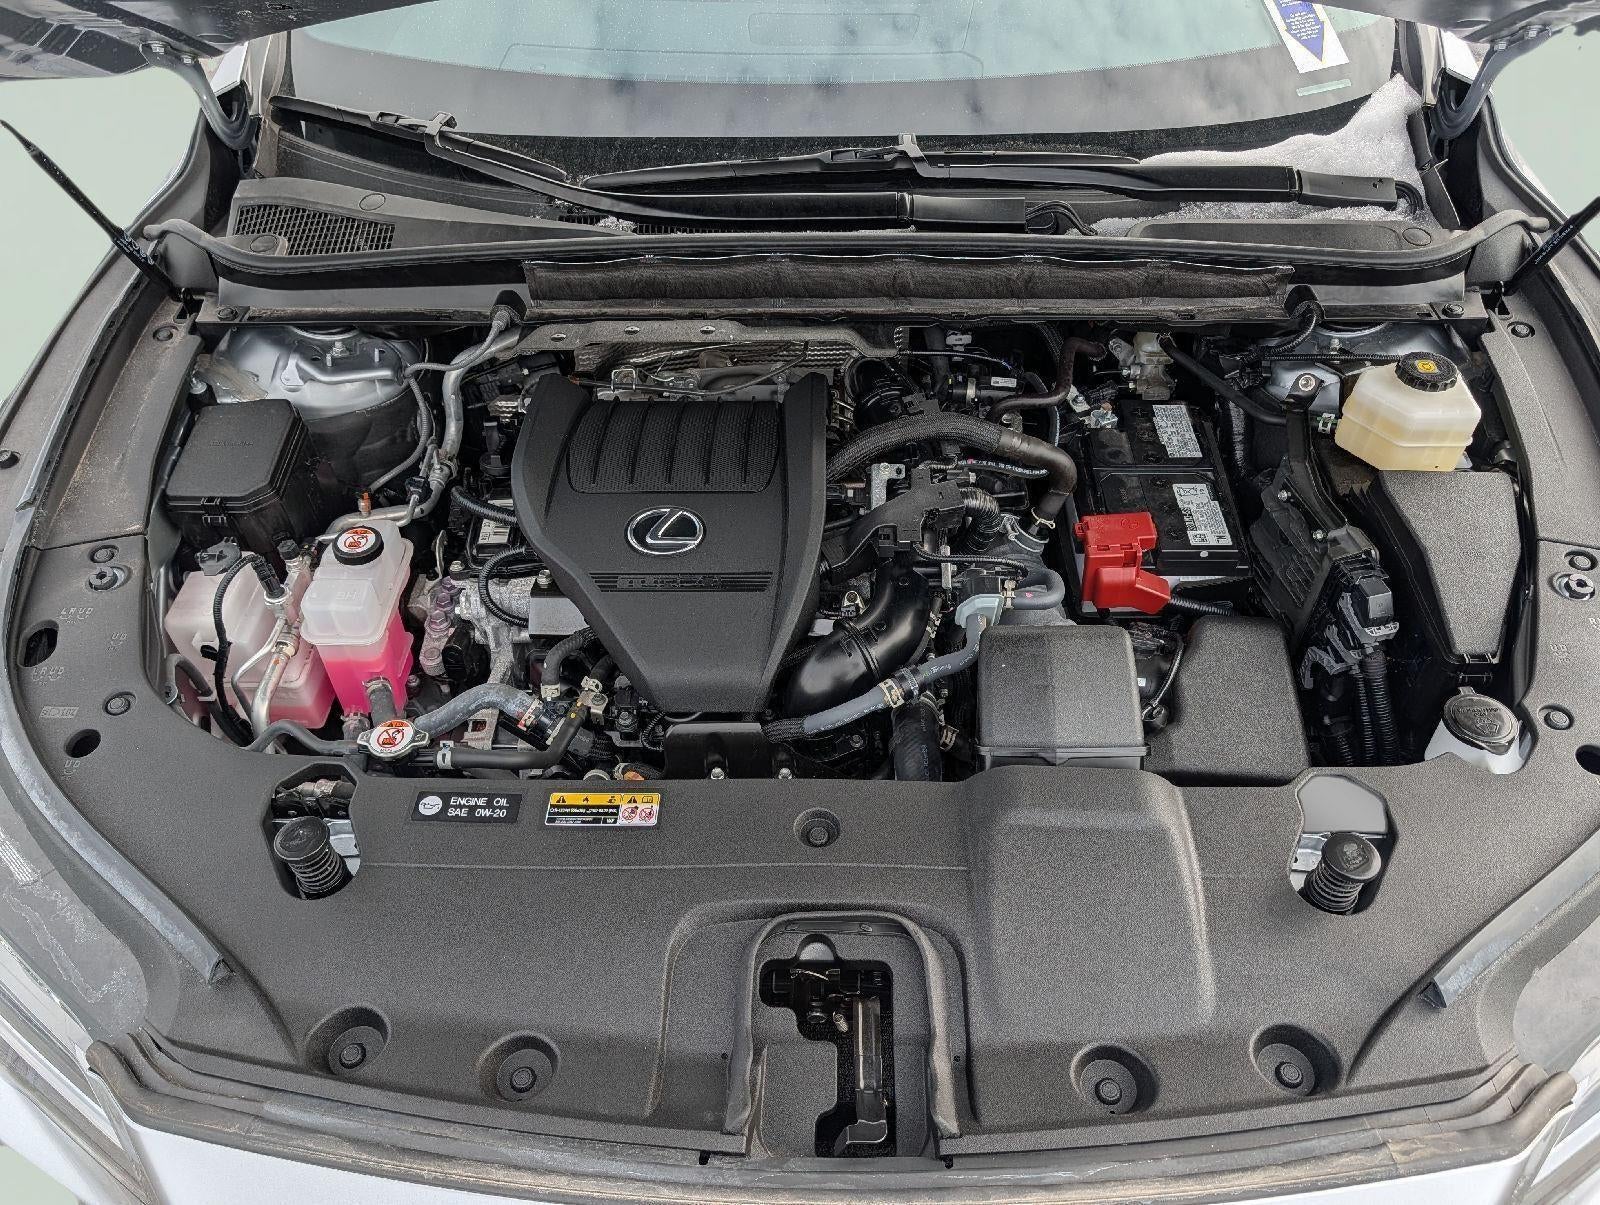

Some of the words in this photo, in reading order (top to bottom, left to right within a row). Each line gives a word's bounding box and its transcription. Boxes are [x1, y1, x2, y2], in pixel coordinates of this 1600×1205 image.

[450, 796, 488, 806] ENGINE
[493, 797, 510, 807] OIL
[447, 807, 469, 817] SAE
[475, 808, 507, 818] 0W-20
